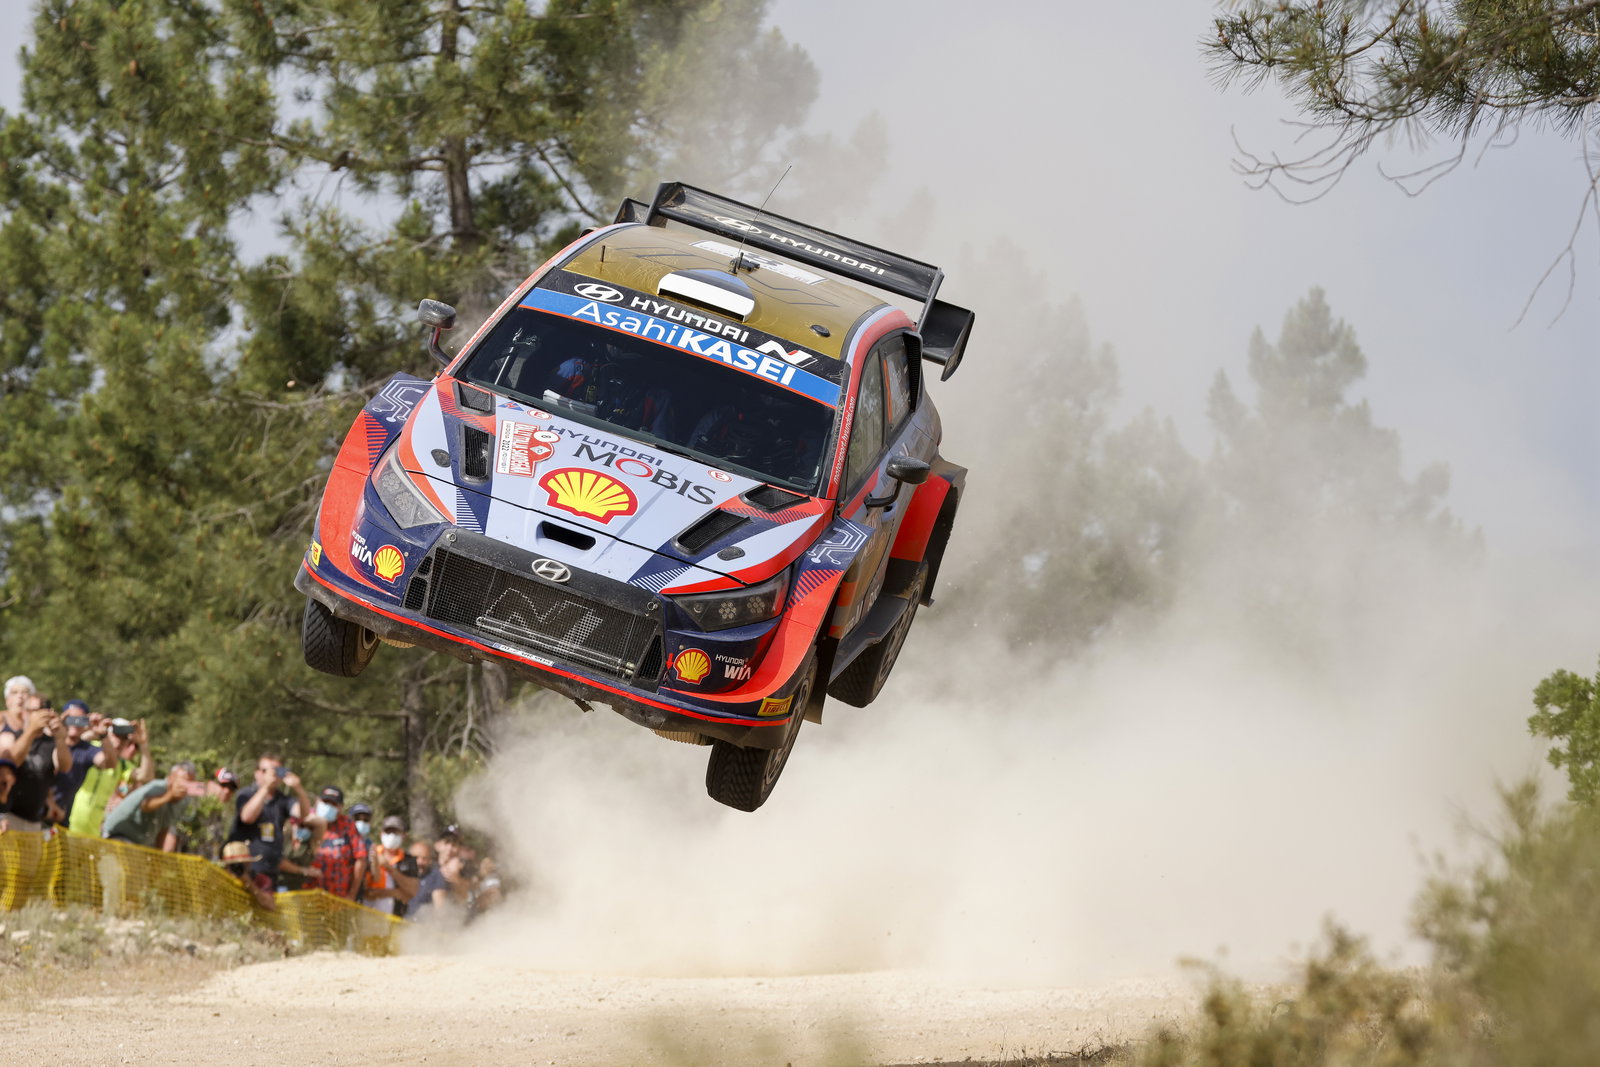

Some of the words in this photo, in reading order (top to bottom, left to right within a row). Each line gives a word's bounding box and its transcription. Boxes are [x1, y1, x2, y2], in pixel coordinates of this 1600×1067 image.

[770, 233, 886, 276] HYUNDAI
[630, 296, 749, 342] HYUNDAI
[572, 301, 797, 386] AsahiKASEI
[501, 440, 511, 451] 2022
[547, 425, 664, 467] HYUNDAI
[833, 396, 857, 485] motorsport.hyundai.com
[572, 443, 716, 505] MOBIS
[715, 654, 745, 665] HYUNDAI
